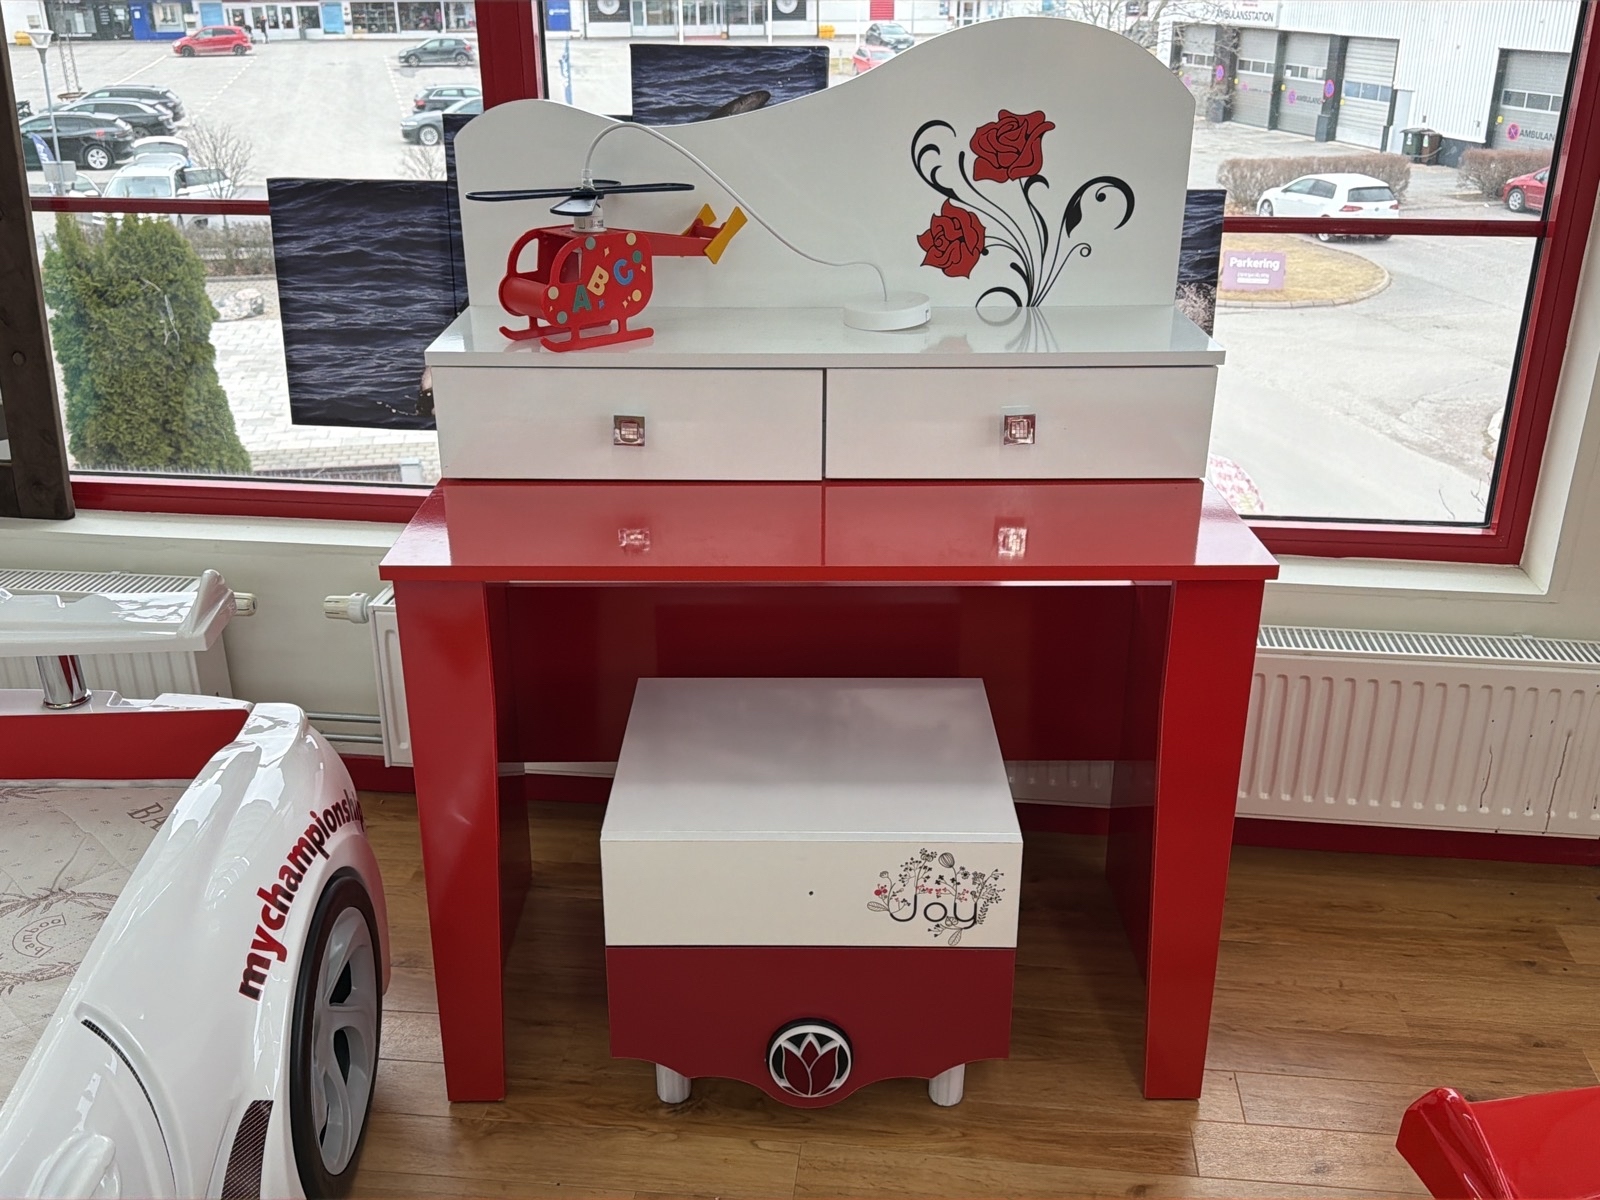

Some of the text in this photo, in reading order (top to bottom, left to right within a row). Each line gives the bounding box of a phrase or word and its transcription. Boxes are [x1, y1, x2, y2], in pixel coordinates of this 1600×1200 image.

[1229, 256, 1280, 272] Parkering
[126, 801, 169, 832] BA
[22, 918, 62, 956] bamboo
